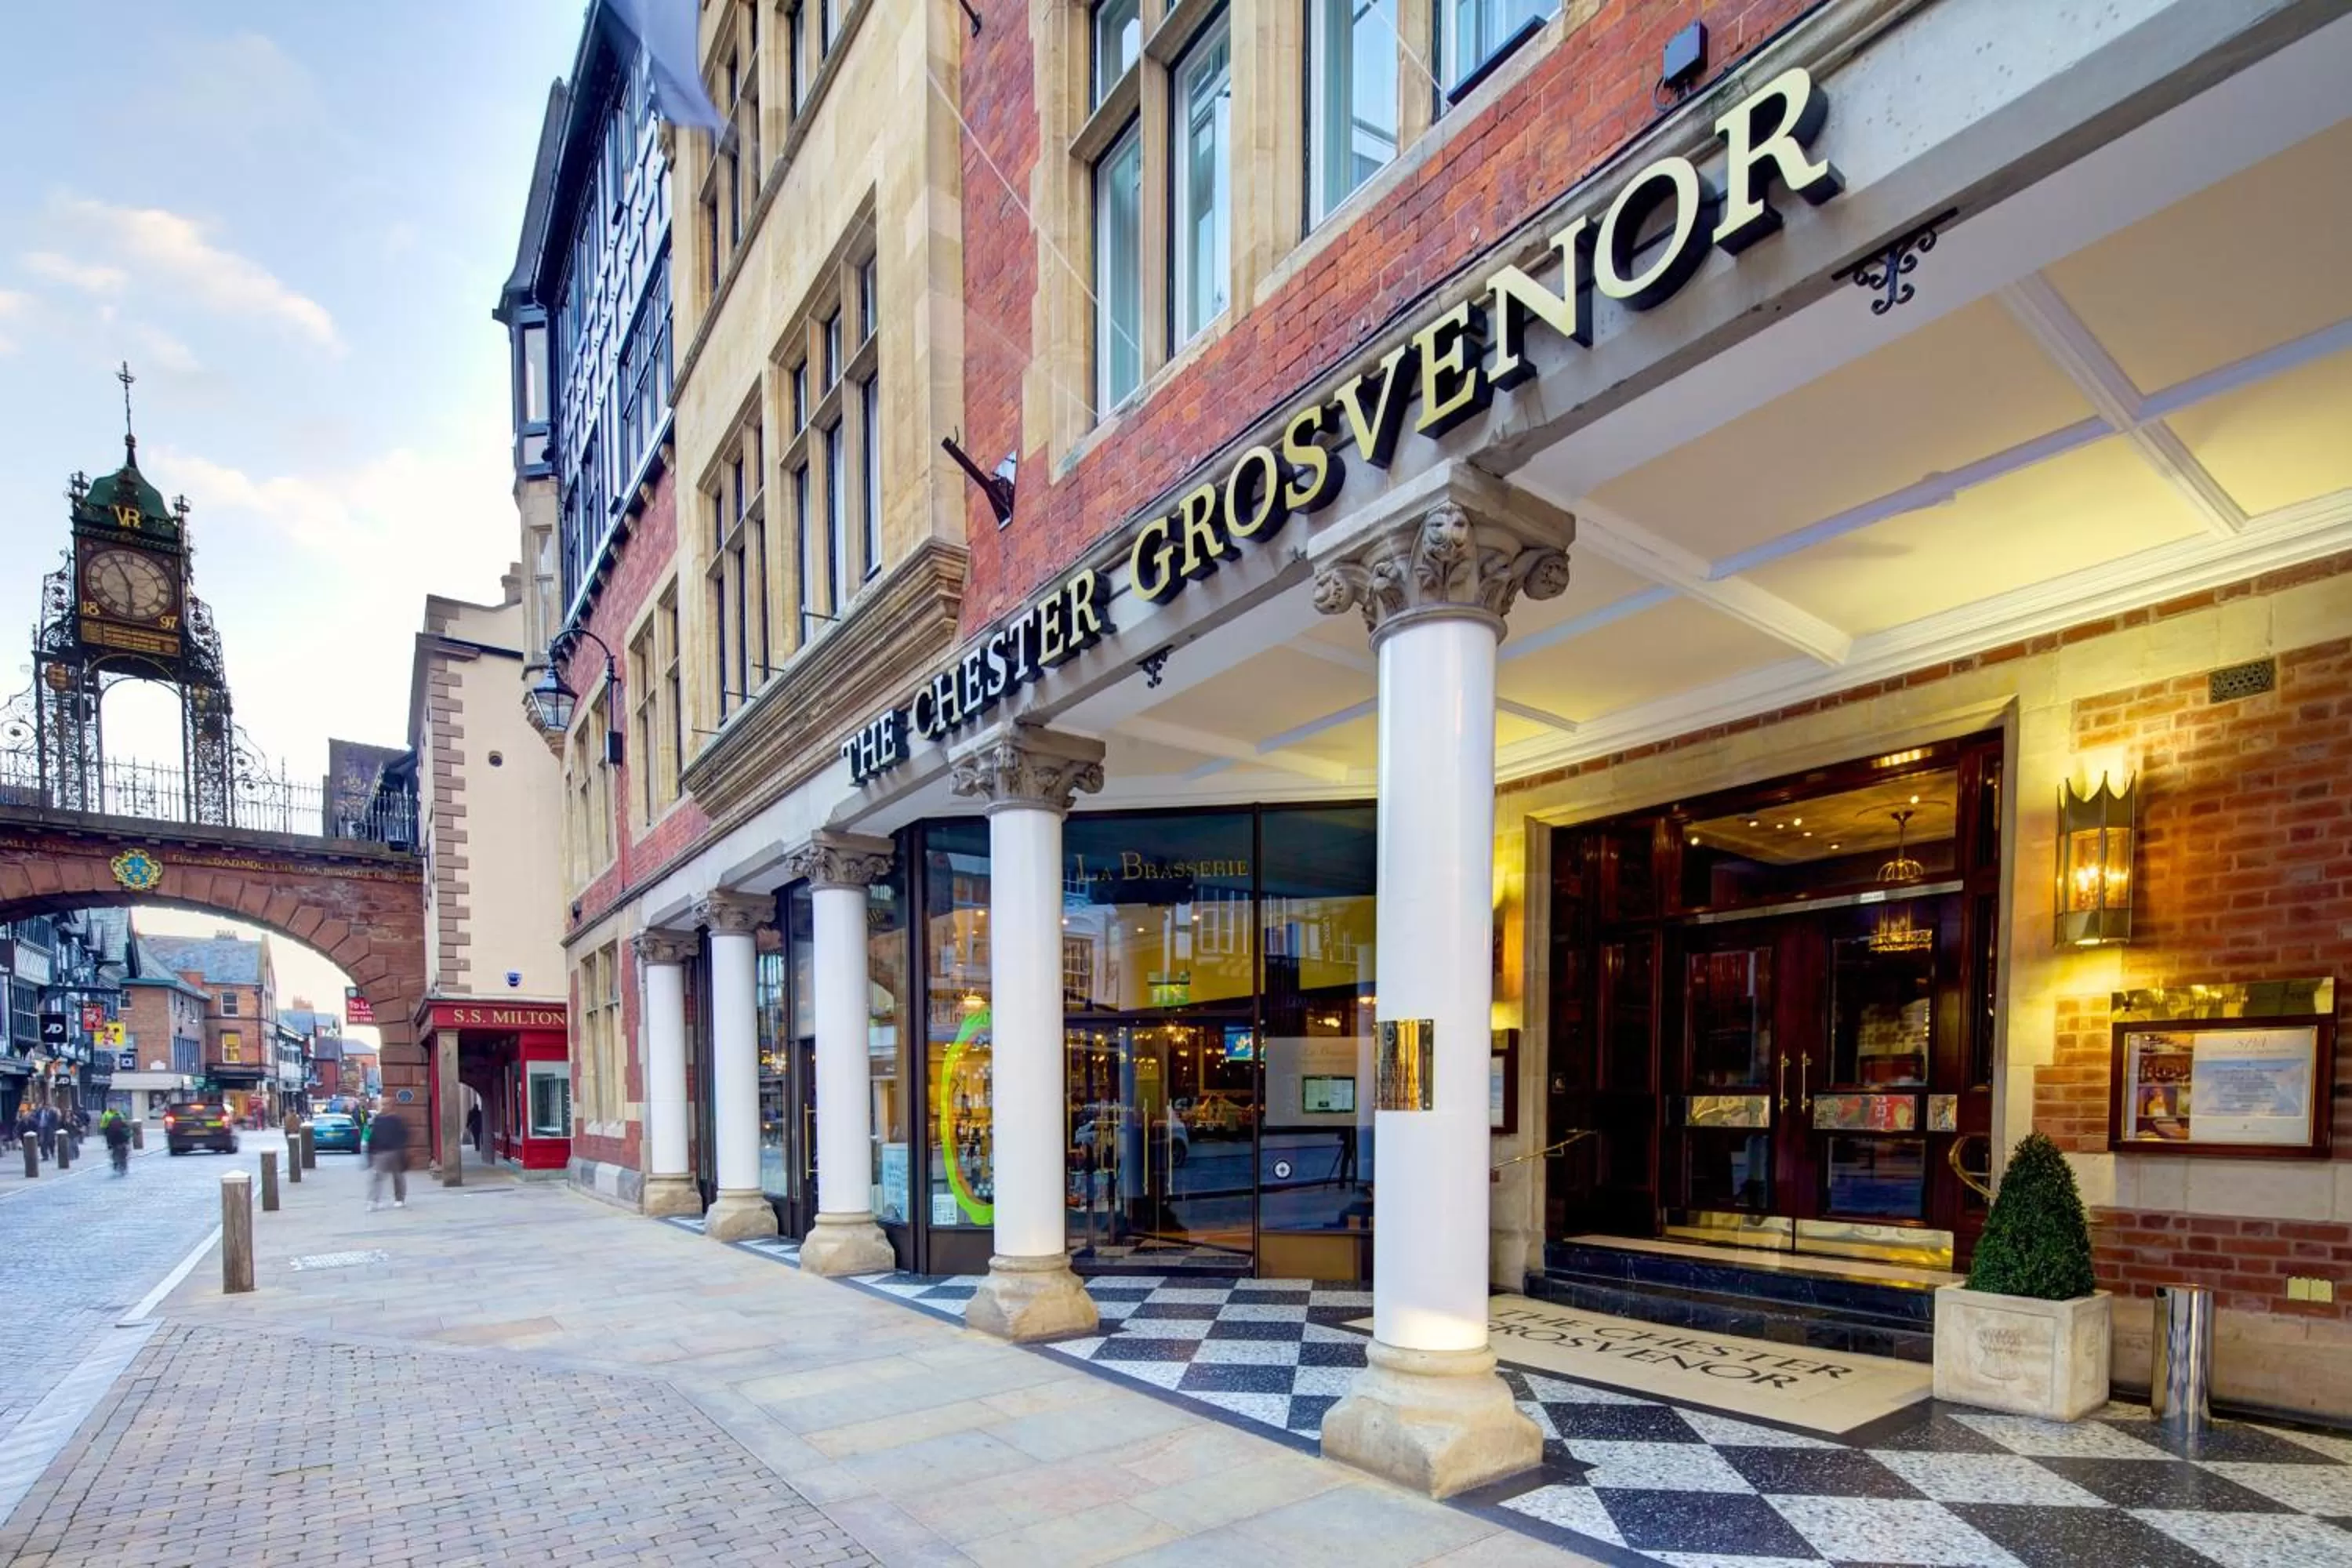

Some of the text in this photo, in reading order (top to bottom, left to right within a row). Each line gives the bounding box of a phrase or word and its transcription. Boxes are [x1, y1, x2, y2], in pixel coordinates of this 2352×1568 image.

[841, 67, 1837, 785] THE CHESTER GROSVENOR
[112, 505, 141, 528] VR
[82, 601, 178, 628] 18 97
[44, 1023, 64, 1034] JD
[453, 1009, 566, 1025] S.S. MILTON
[1593, 1327, 1853, 1378] CHESTER
